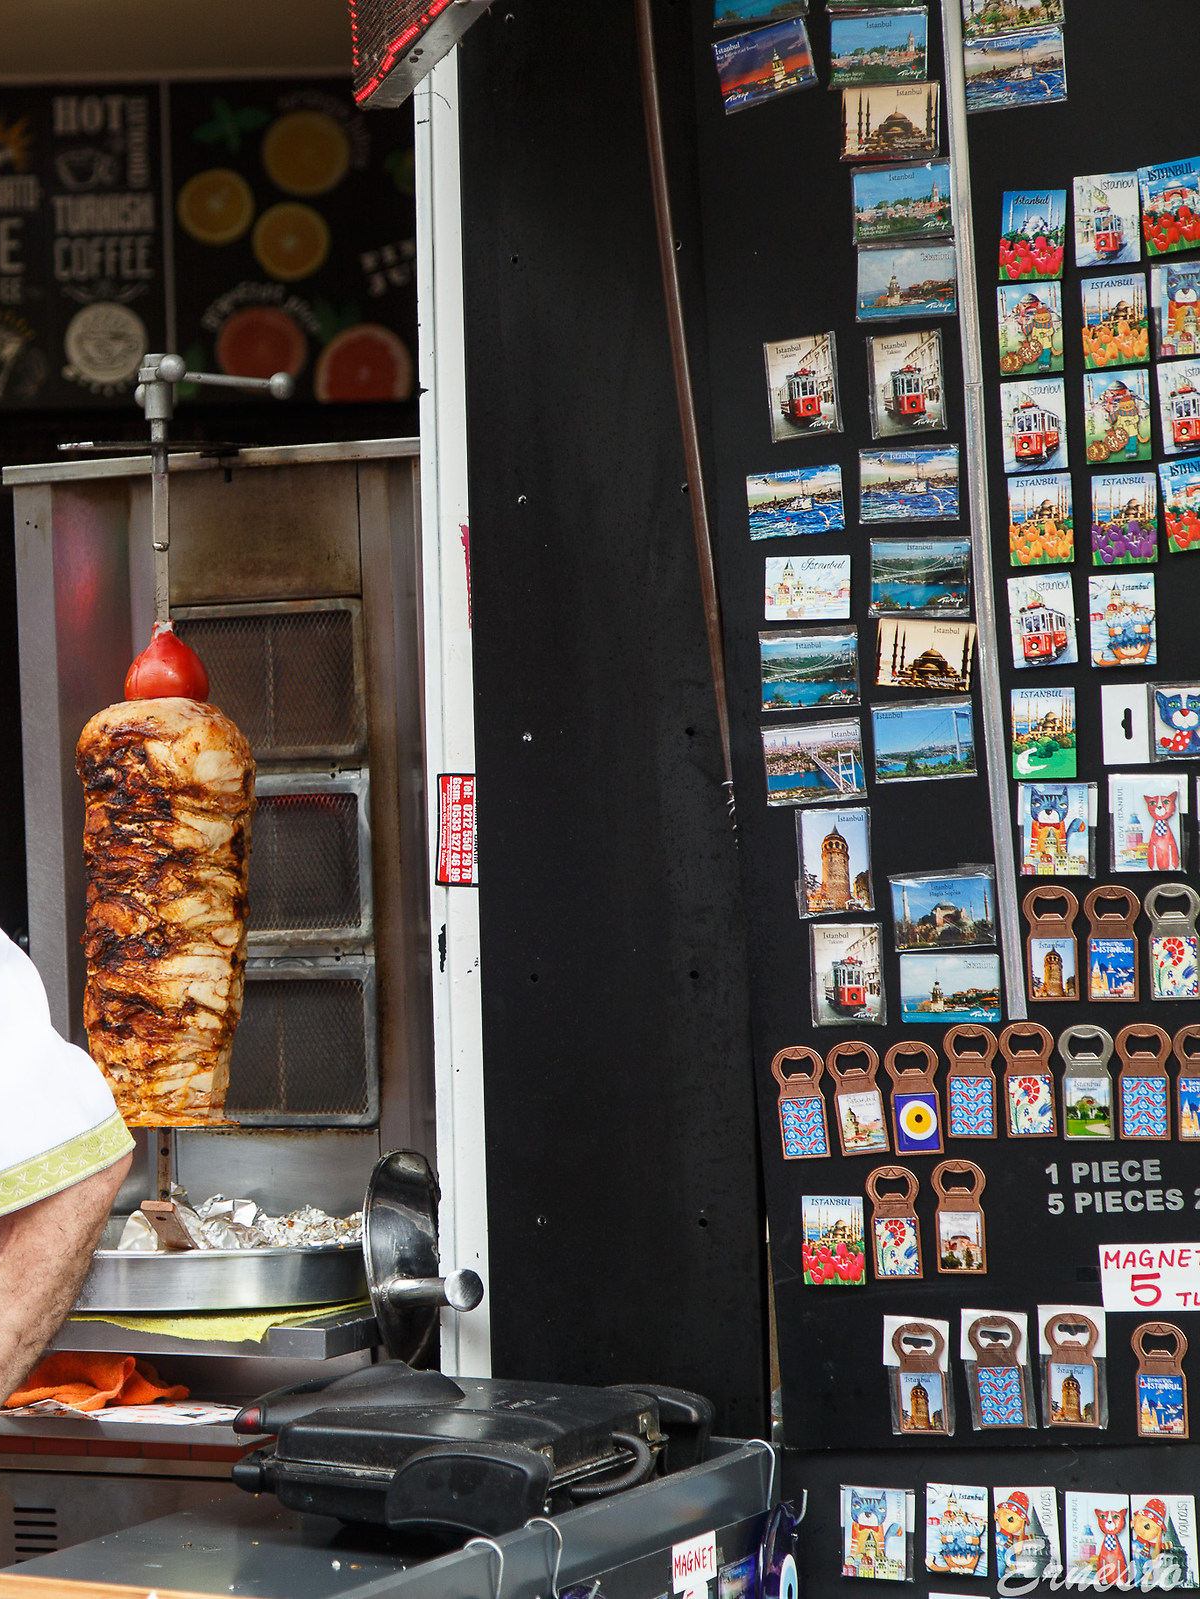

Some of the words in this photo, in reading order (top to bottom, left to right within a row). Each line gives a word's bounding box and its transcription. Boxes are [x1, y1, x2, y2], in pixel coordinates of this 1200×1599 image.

[52, 96, 125, 136] HOT
[53, 236, 156, 281] COFFEE
[452, 804, 462, 831] 0533
[463, 804, 473, 829] 0212
[452, 832, 461, 852] 527
[462, 830, 473, 851] 550
[451, 852, 461, 867] 46
[462, 852, 472, 866] 29
[461, 867, 472, 880] 78
[1045, 1163, 1059, 1185] 1
[1071, 1159, 1162, 1184] PIECE
[1047, 1193, 1065, 1215] 5
[1074, 1188, 1185, 1214] PIECES
[1130, 1272, 1162, 1307] 5
[674, 1545, 714, 1580] MAGNET
